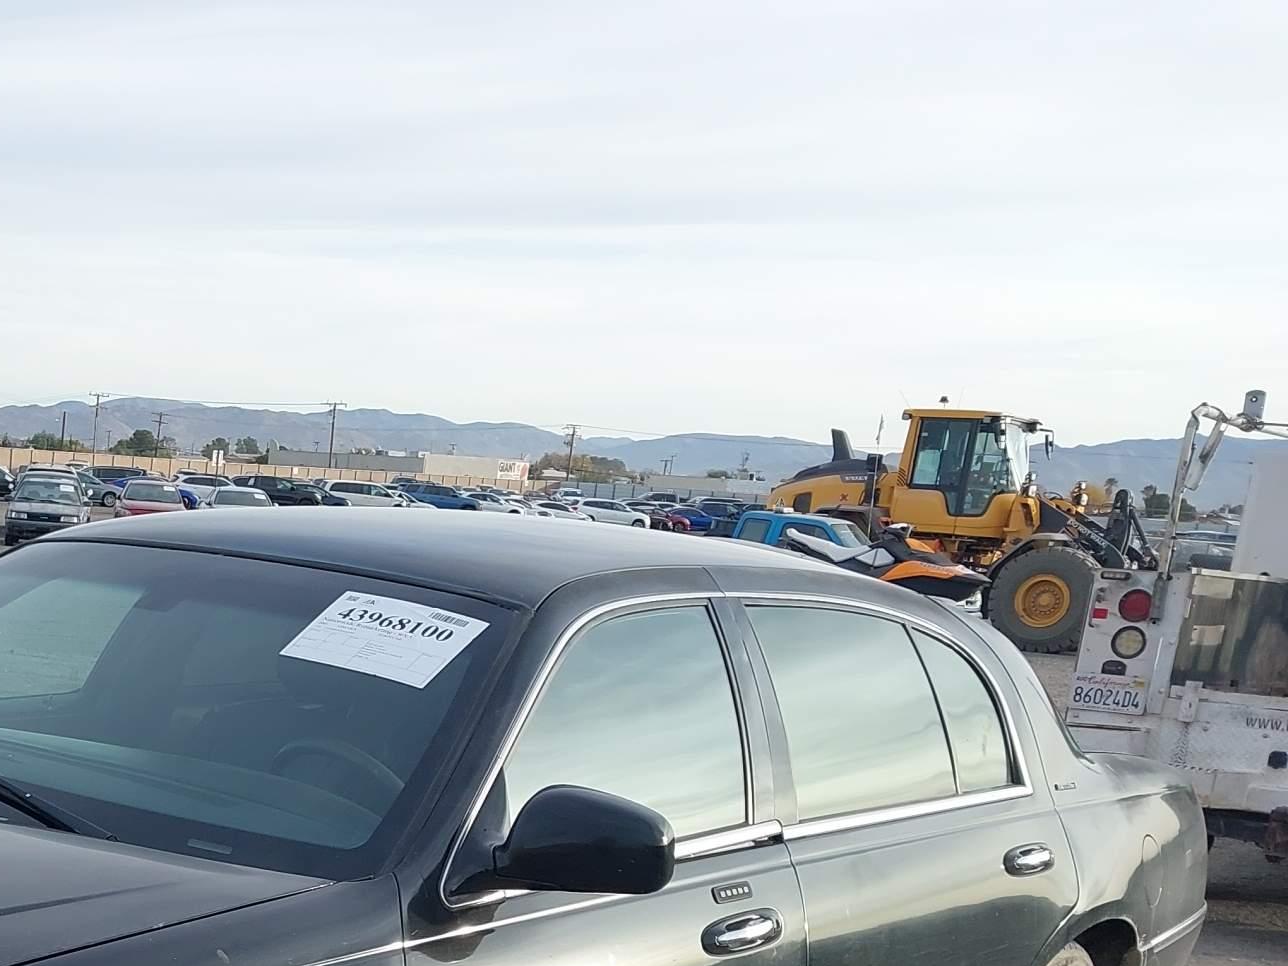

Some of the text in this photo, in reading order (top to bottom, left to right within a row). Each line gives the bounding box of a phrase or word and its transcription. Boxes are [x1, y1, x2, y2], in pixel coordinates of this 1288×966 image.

[337, 607, 454, 642] 43968100
[1073, 686, 1140, 709] 86024D4
[1246, 717, 1288, 731] www.
